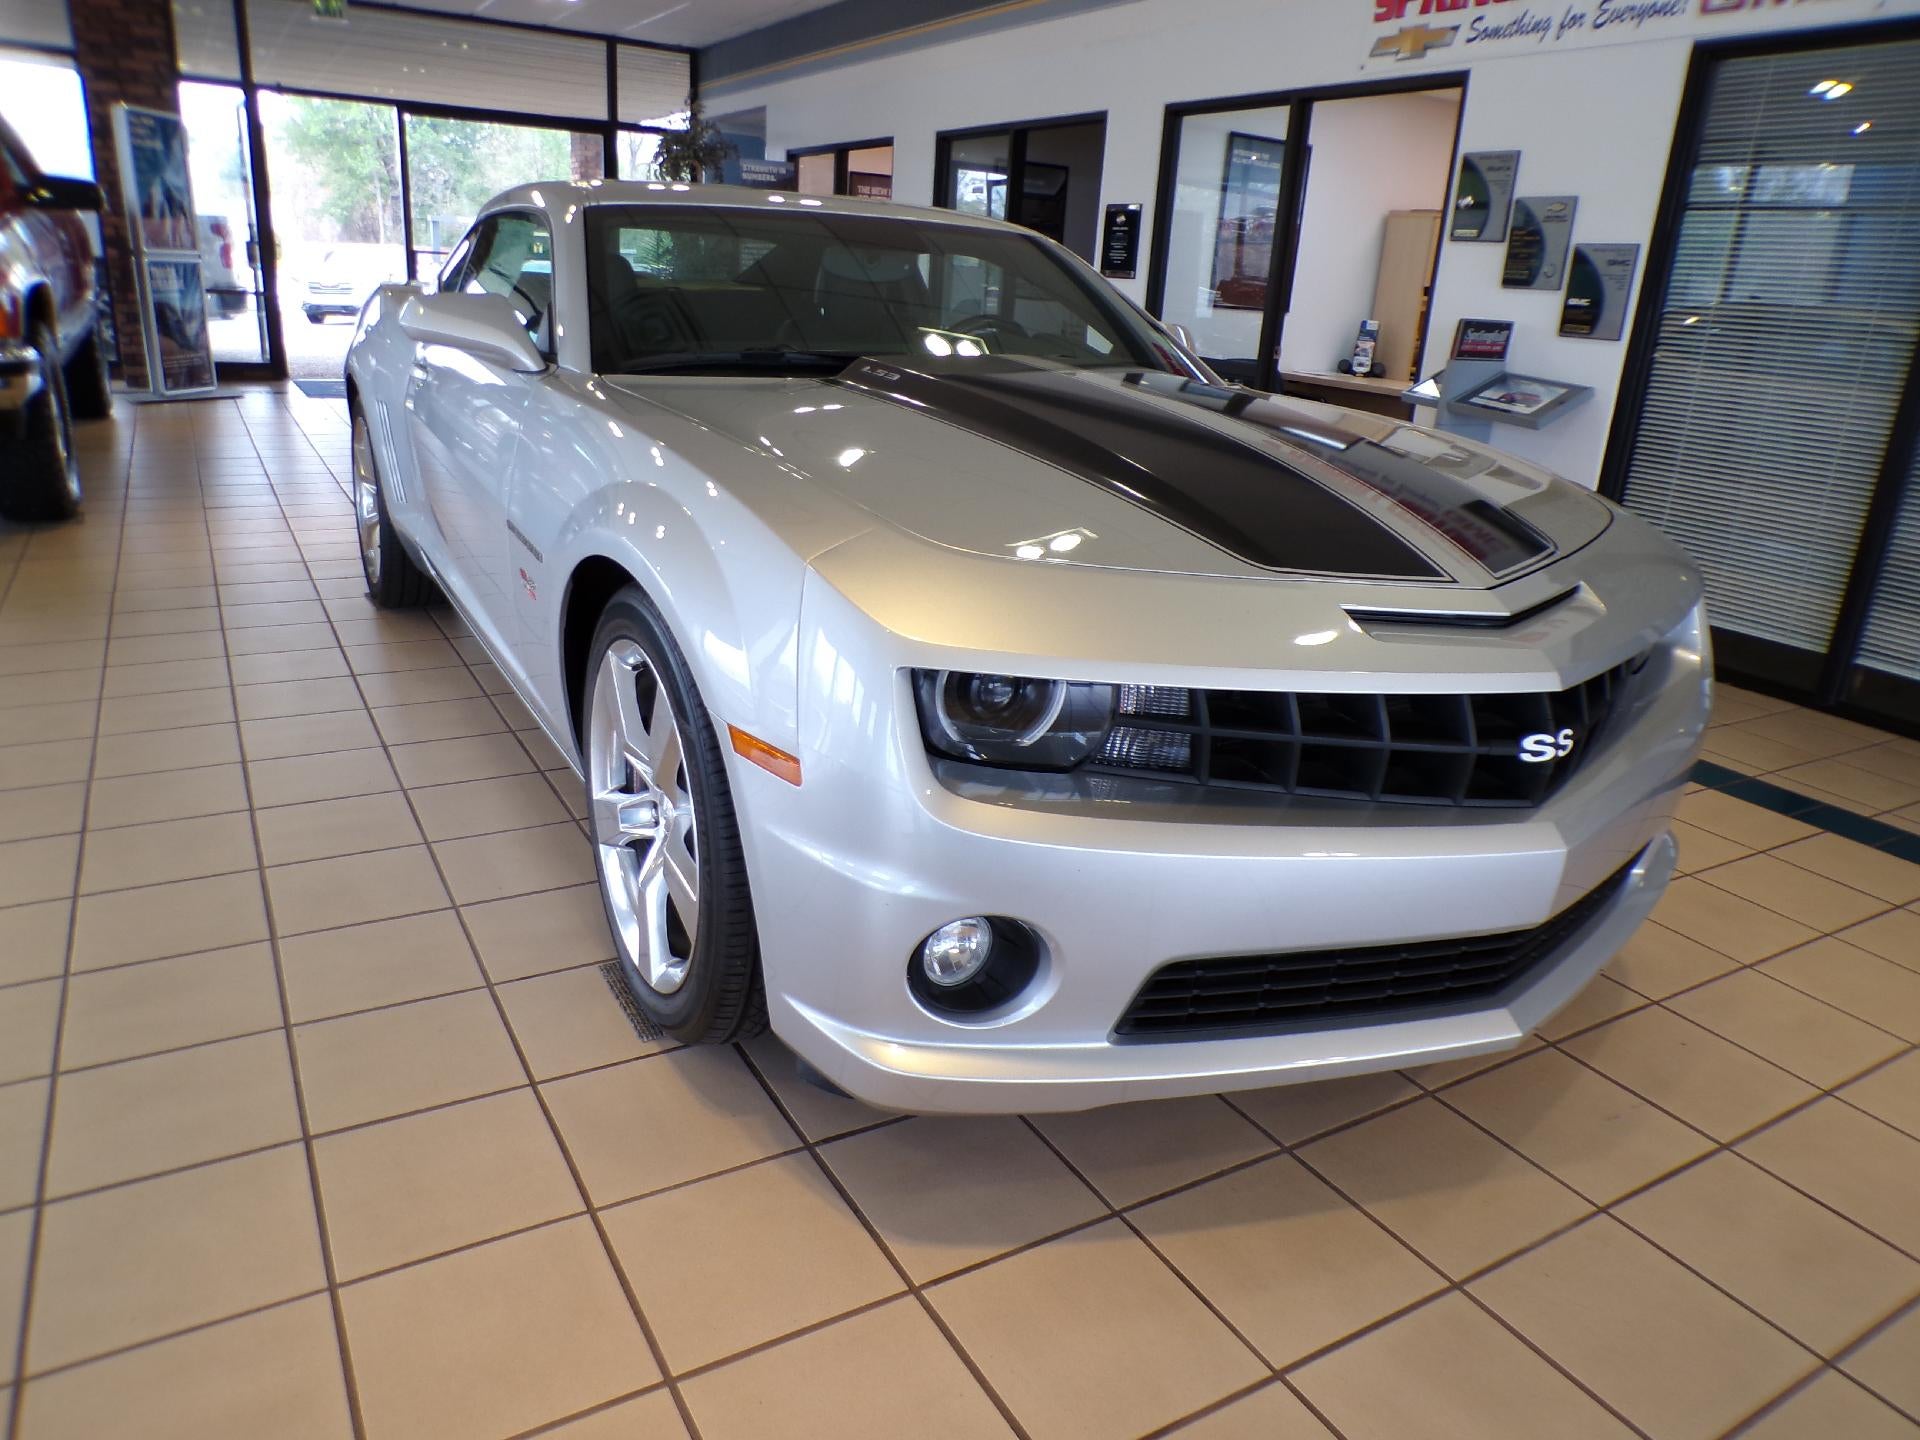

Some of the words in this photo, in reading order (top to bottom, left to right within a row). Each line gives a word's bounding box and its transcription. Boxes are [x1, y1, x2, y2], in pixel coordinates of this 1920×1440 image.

[1466, 9, 1551, 43] Something
[1555, 5, 1586, 41] for
[1519, 728, 1574, 762] SS
